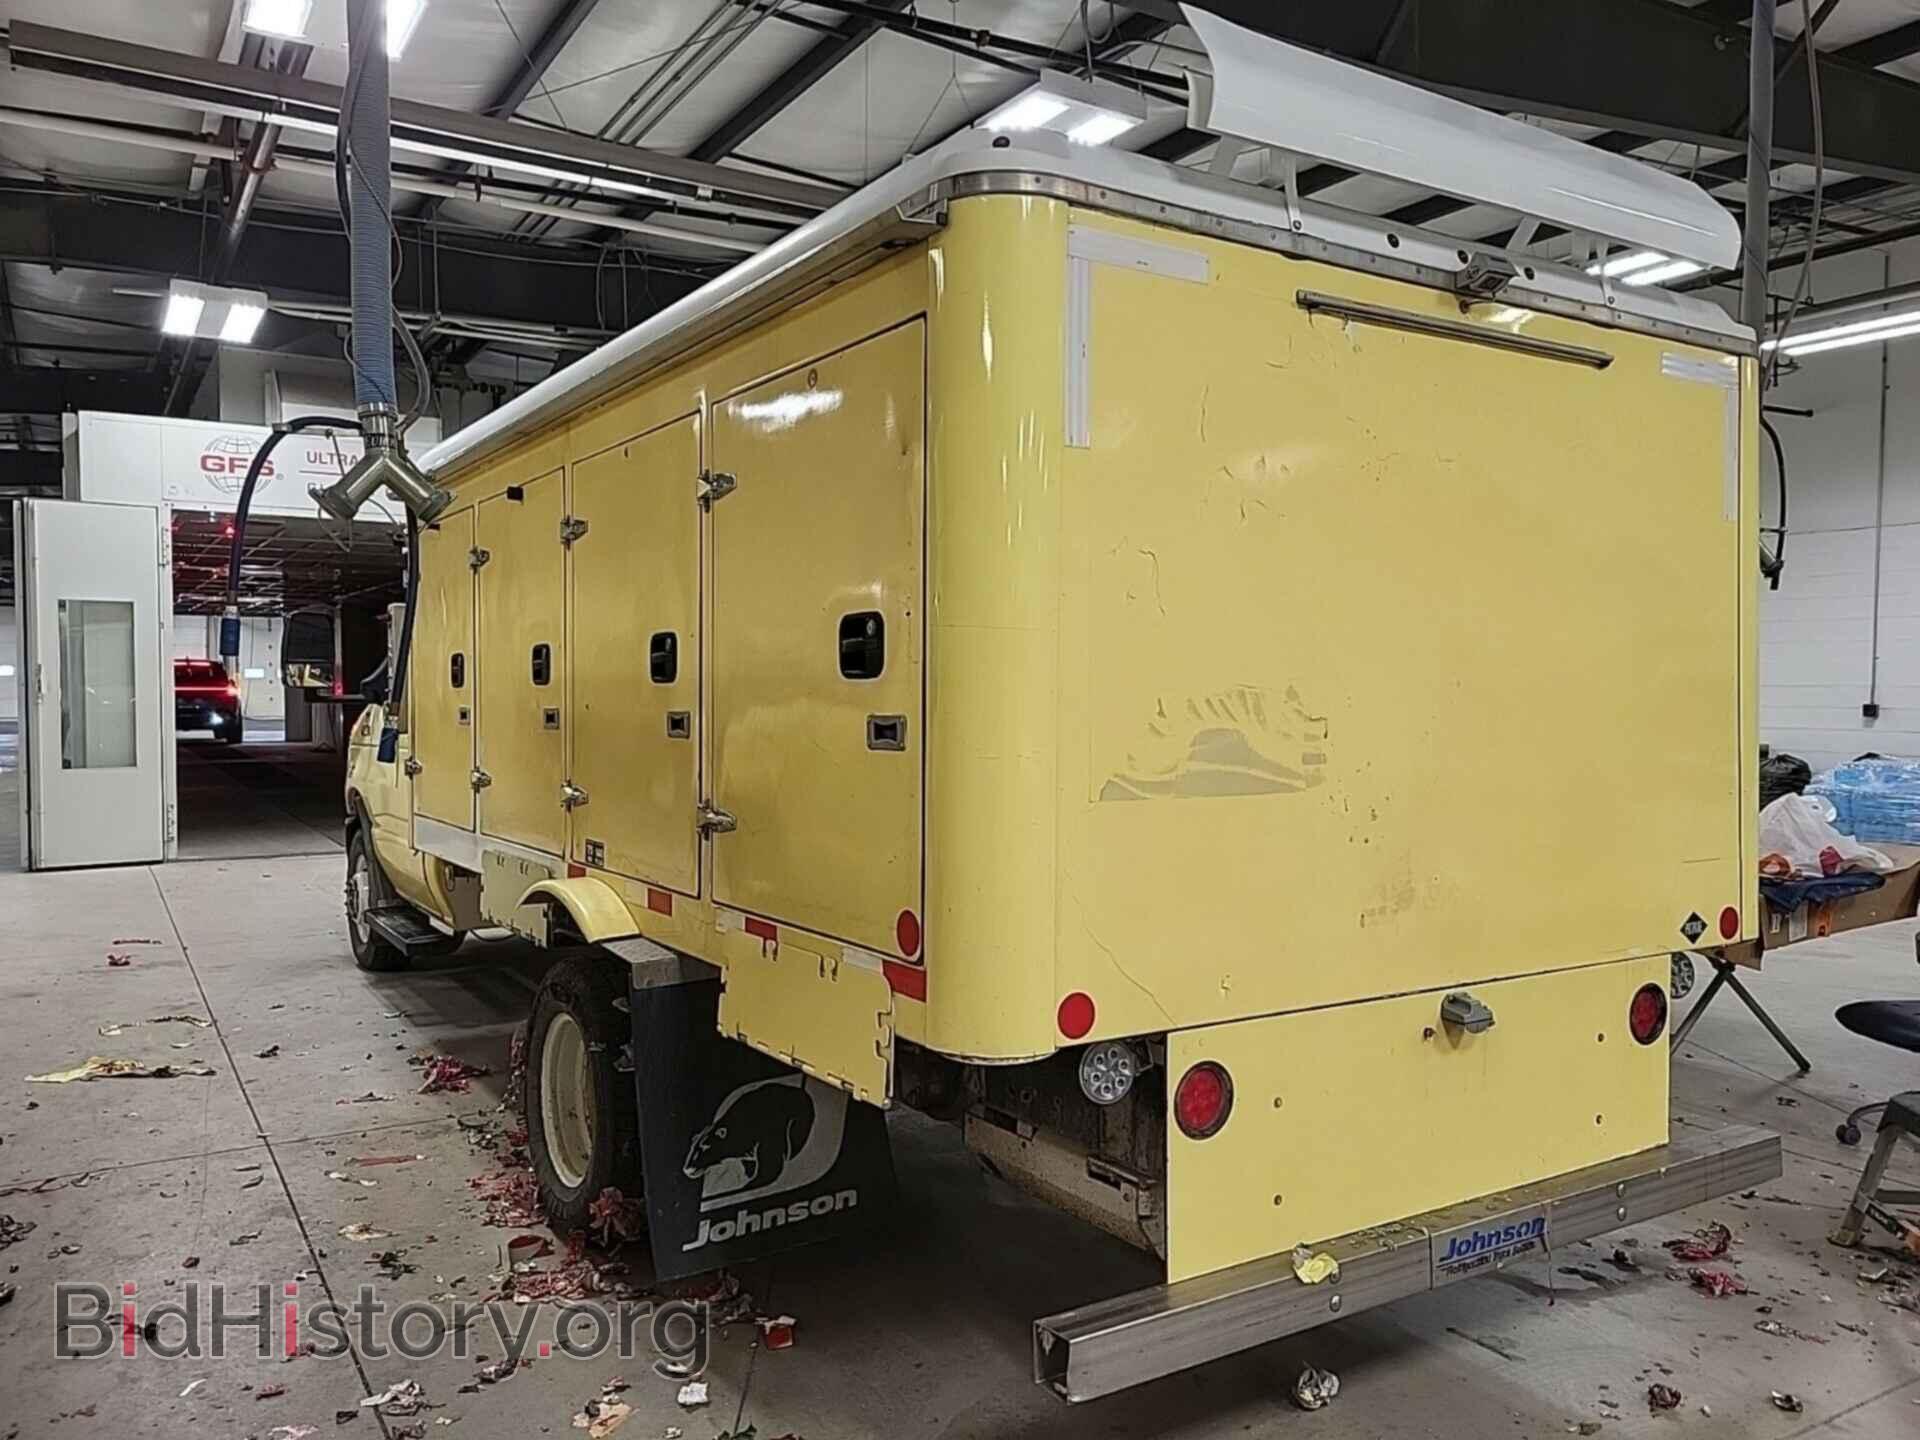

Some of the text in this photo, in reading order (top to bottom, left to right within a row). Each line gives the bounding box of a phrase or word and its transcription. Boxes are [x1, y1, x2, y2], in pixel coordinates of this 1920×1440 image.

[200, 455, 274, 476] GFS
[682, 1189, 857, 1252] Johnson
[1439, 1217, 1545, 1262] Johnson
